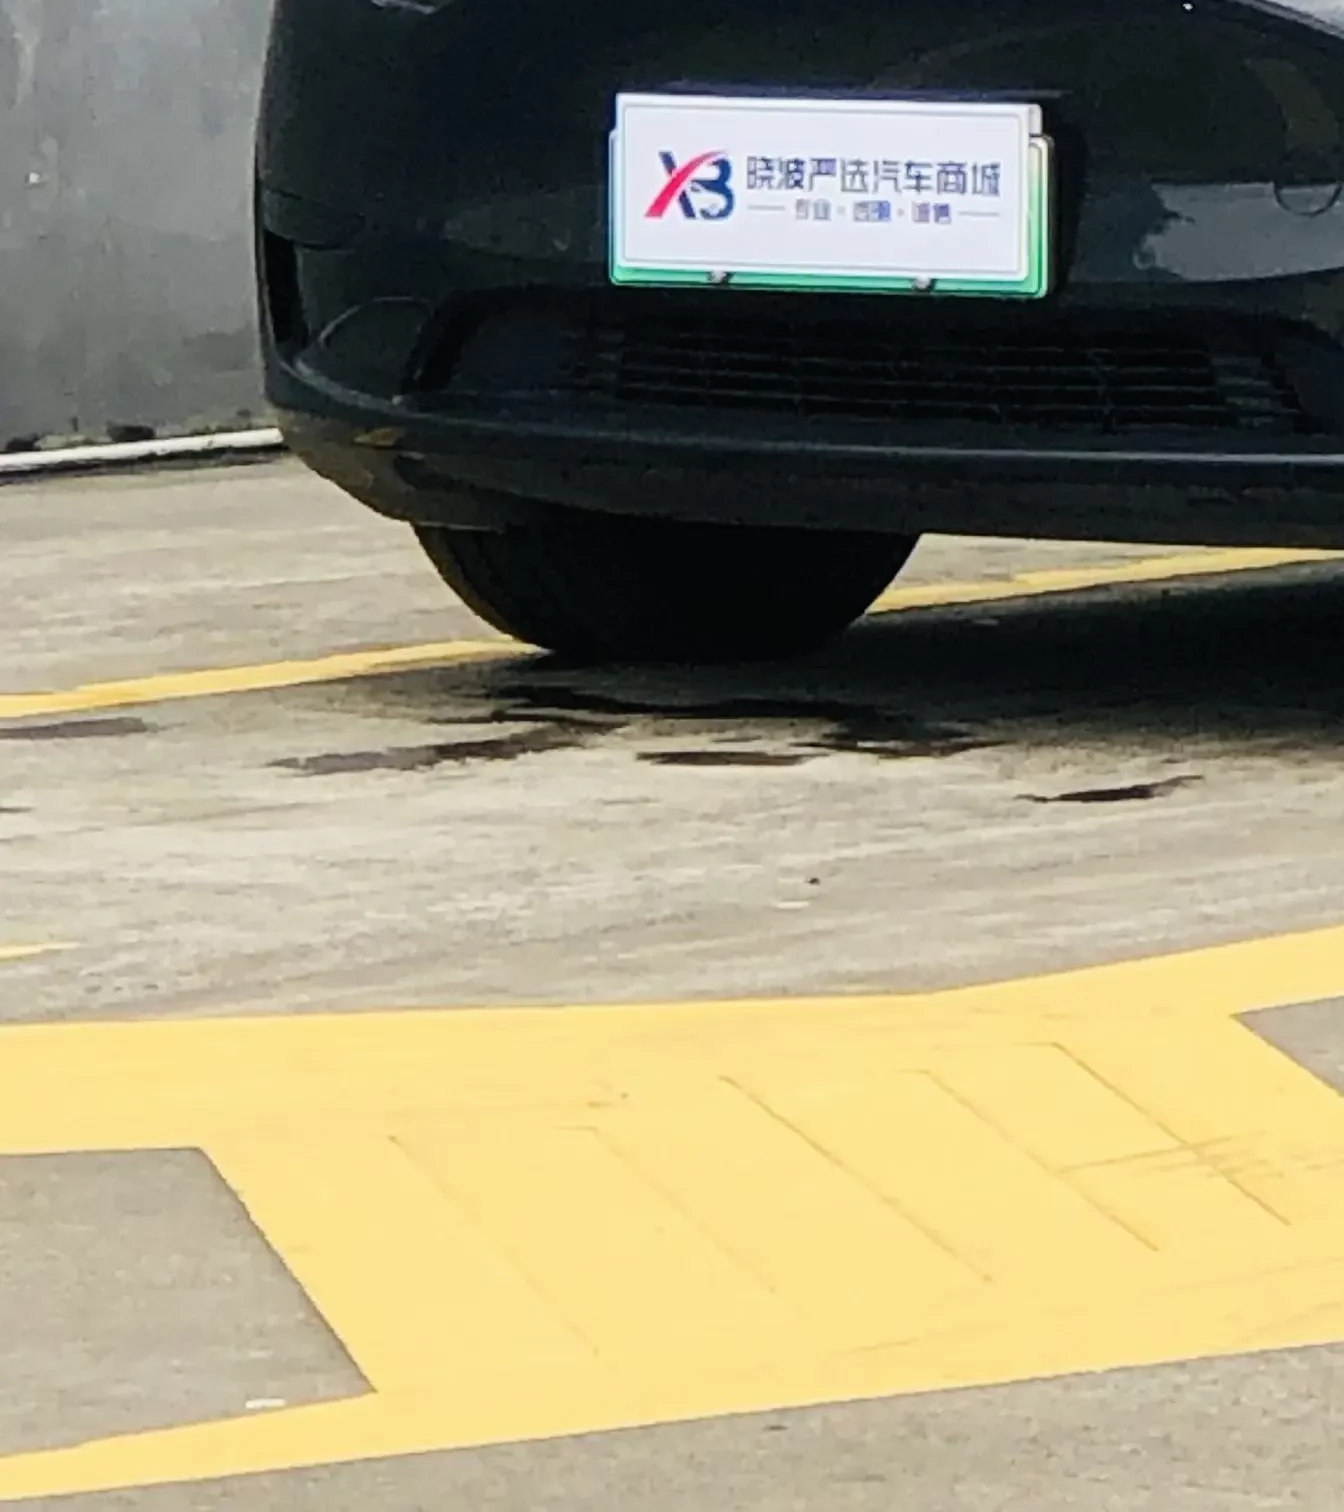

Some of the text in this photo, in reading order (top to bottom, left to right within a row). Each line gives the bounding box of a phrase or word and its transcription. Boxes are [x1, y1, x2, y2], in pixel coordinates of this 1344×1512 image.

[746, 156, 1001, 197] 晓波严选汽车商城
